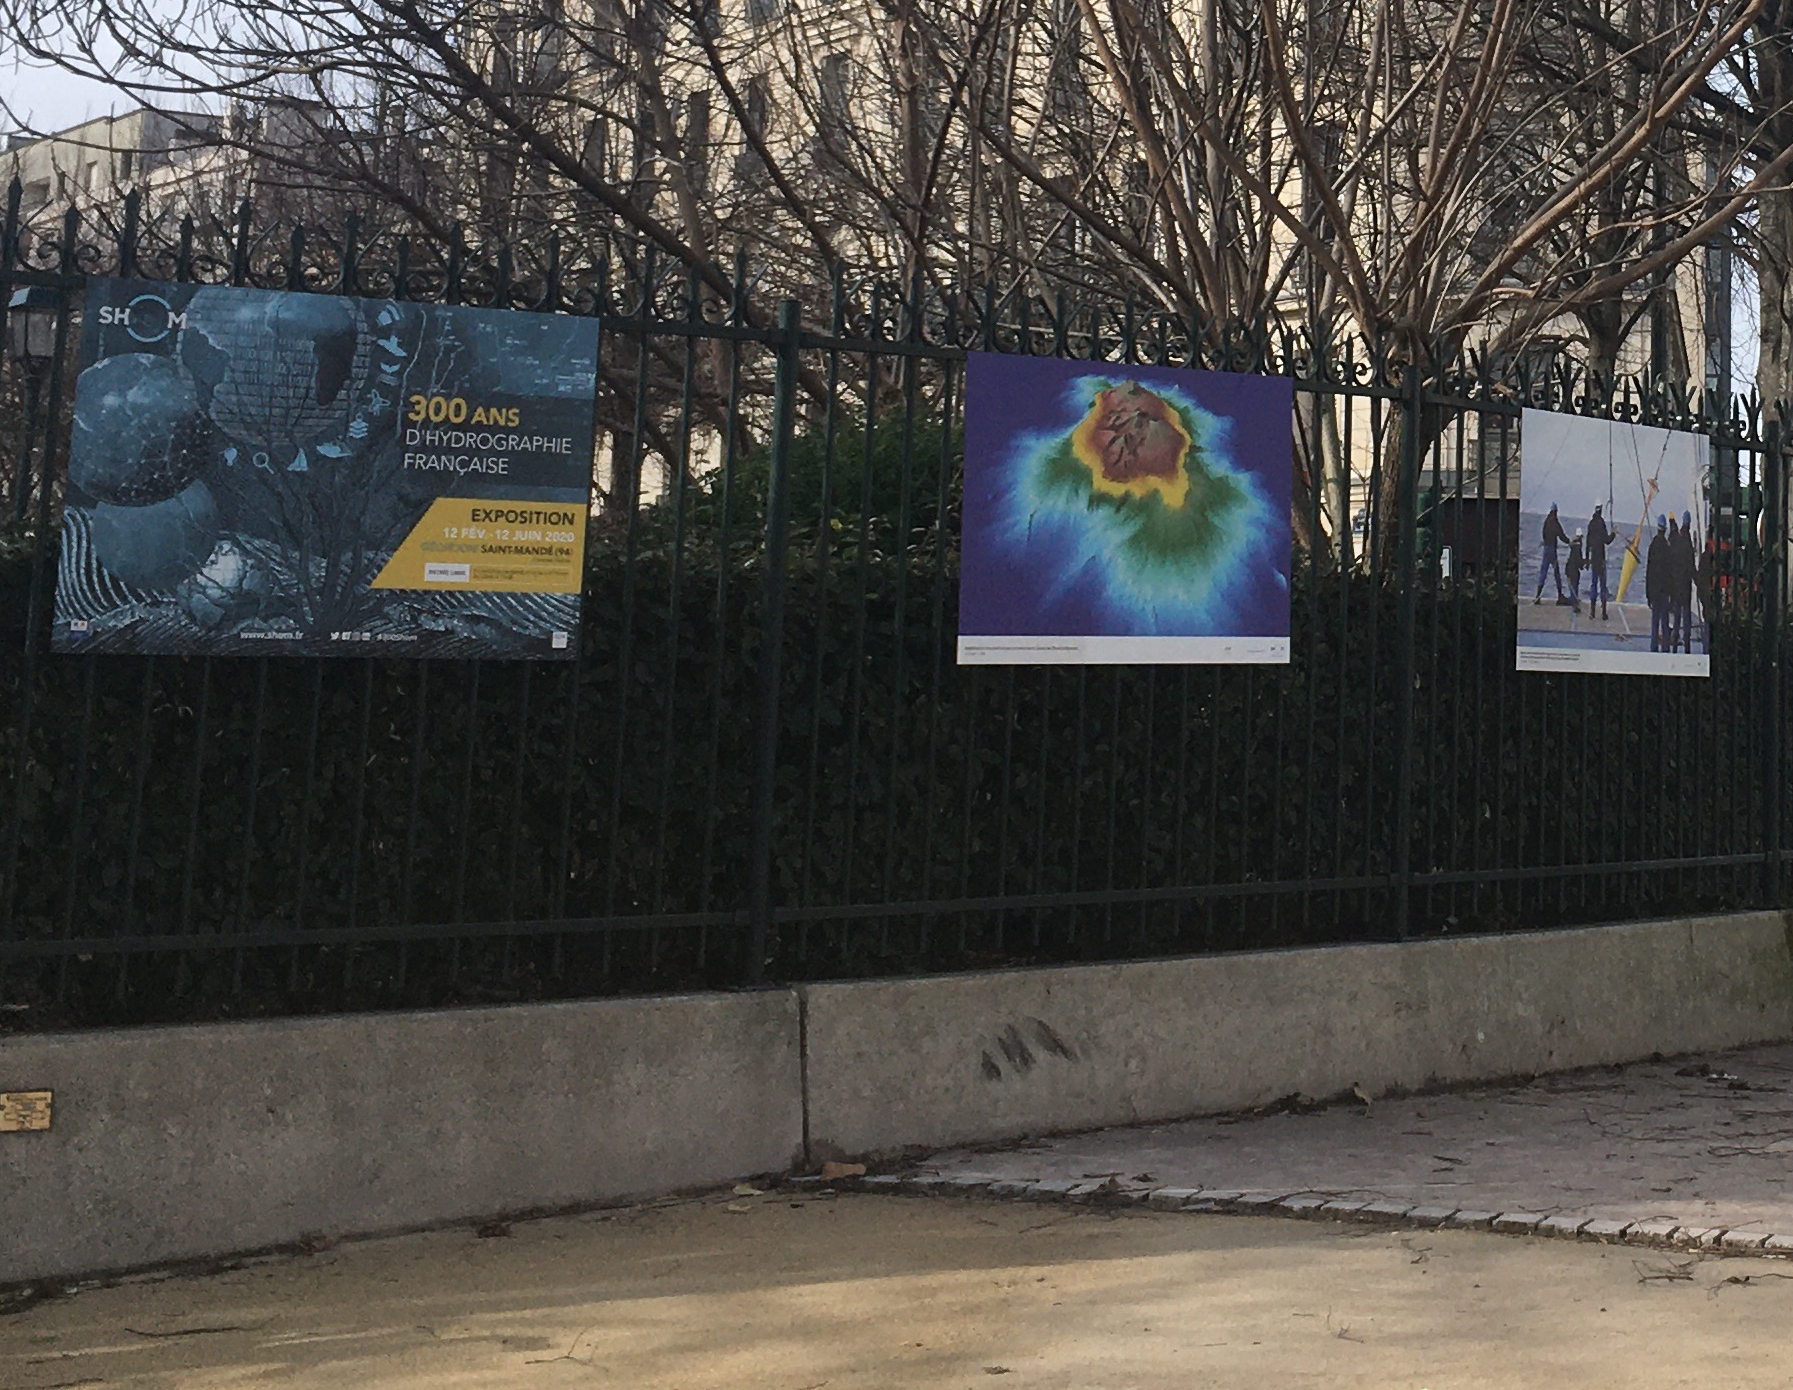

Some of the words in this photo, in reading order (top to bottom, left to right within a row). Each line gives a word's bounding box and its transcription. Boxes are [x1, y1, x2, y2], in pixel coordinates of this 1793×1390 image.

[407, 394, 468, 424] 300
[470, 406, 521, 427] ANS
[405, 428, 573, 454] D'HYDROGRAPHIE
[403, 452, 510, 476] FRANÇAISE
[471, 507, 576, 526] EXPOSITION
[442, 527, 458, 539] 12
[495, 529, 510, 541] 12
[512, 529, 542, 542] JUIN
[545, 531, 575, 543] 2020
